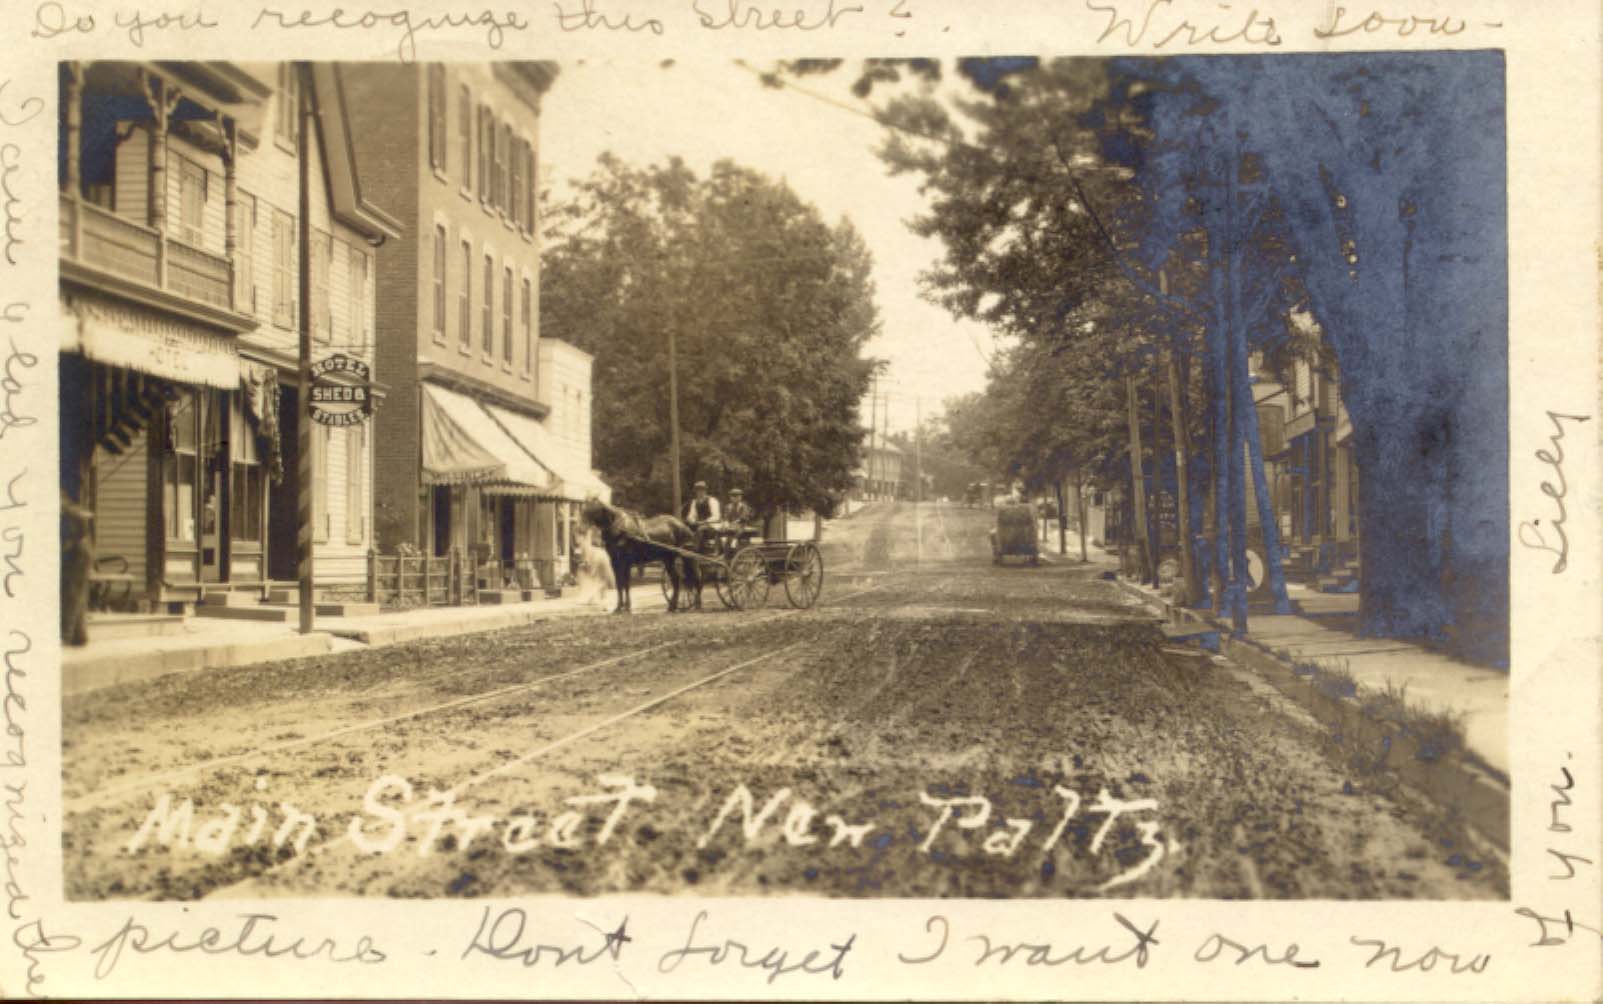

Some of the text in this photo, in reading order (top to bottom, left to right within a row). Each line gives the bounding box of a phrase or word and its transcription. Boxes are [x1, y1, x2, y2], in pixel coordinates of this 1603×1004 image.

[31, 2, 95, 38] Do
[114, 9, 219, 48] you
[251, 8, 528, 63] recognize
[552, 0, 665, 36] this
[1086, 0, 1282, 48] Write
[312, 386, 353, 401] SHED
[964, 911, 1160, 969] want
[1194, 932, 1322, 970] one
[1349, 935, 1492, 975] now
